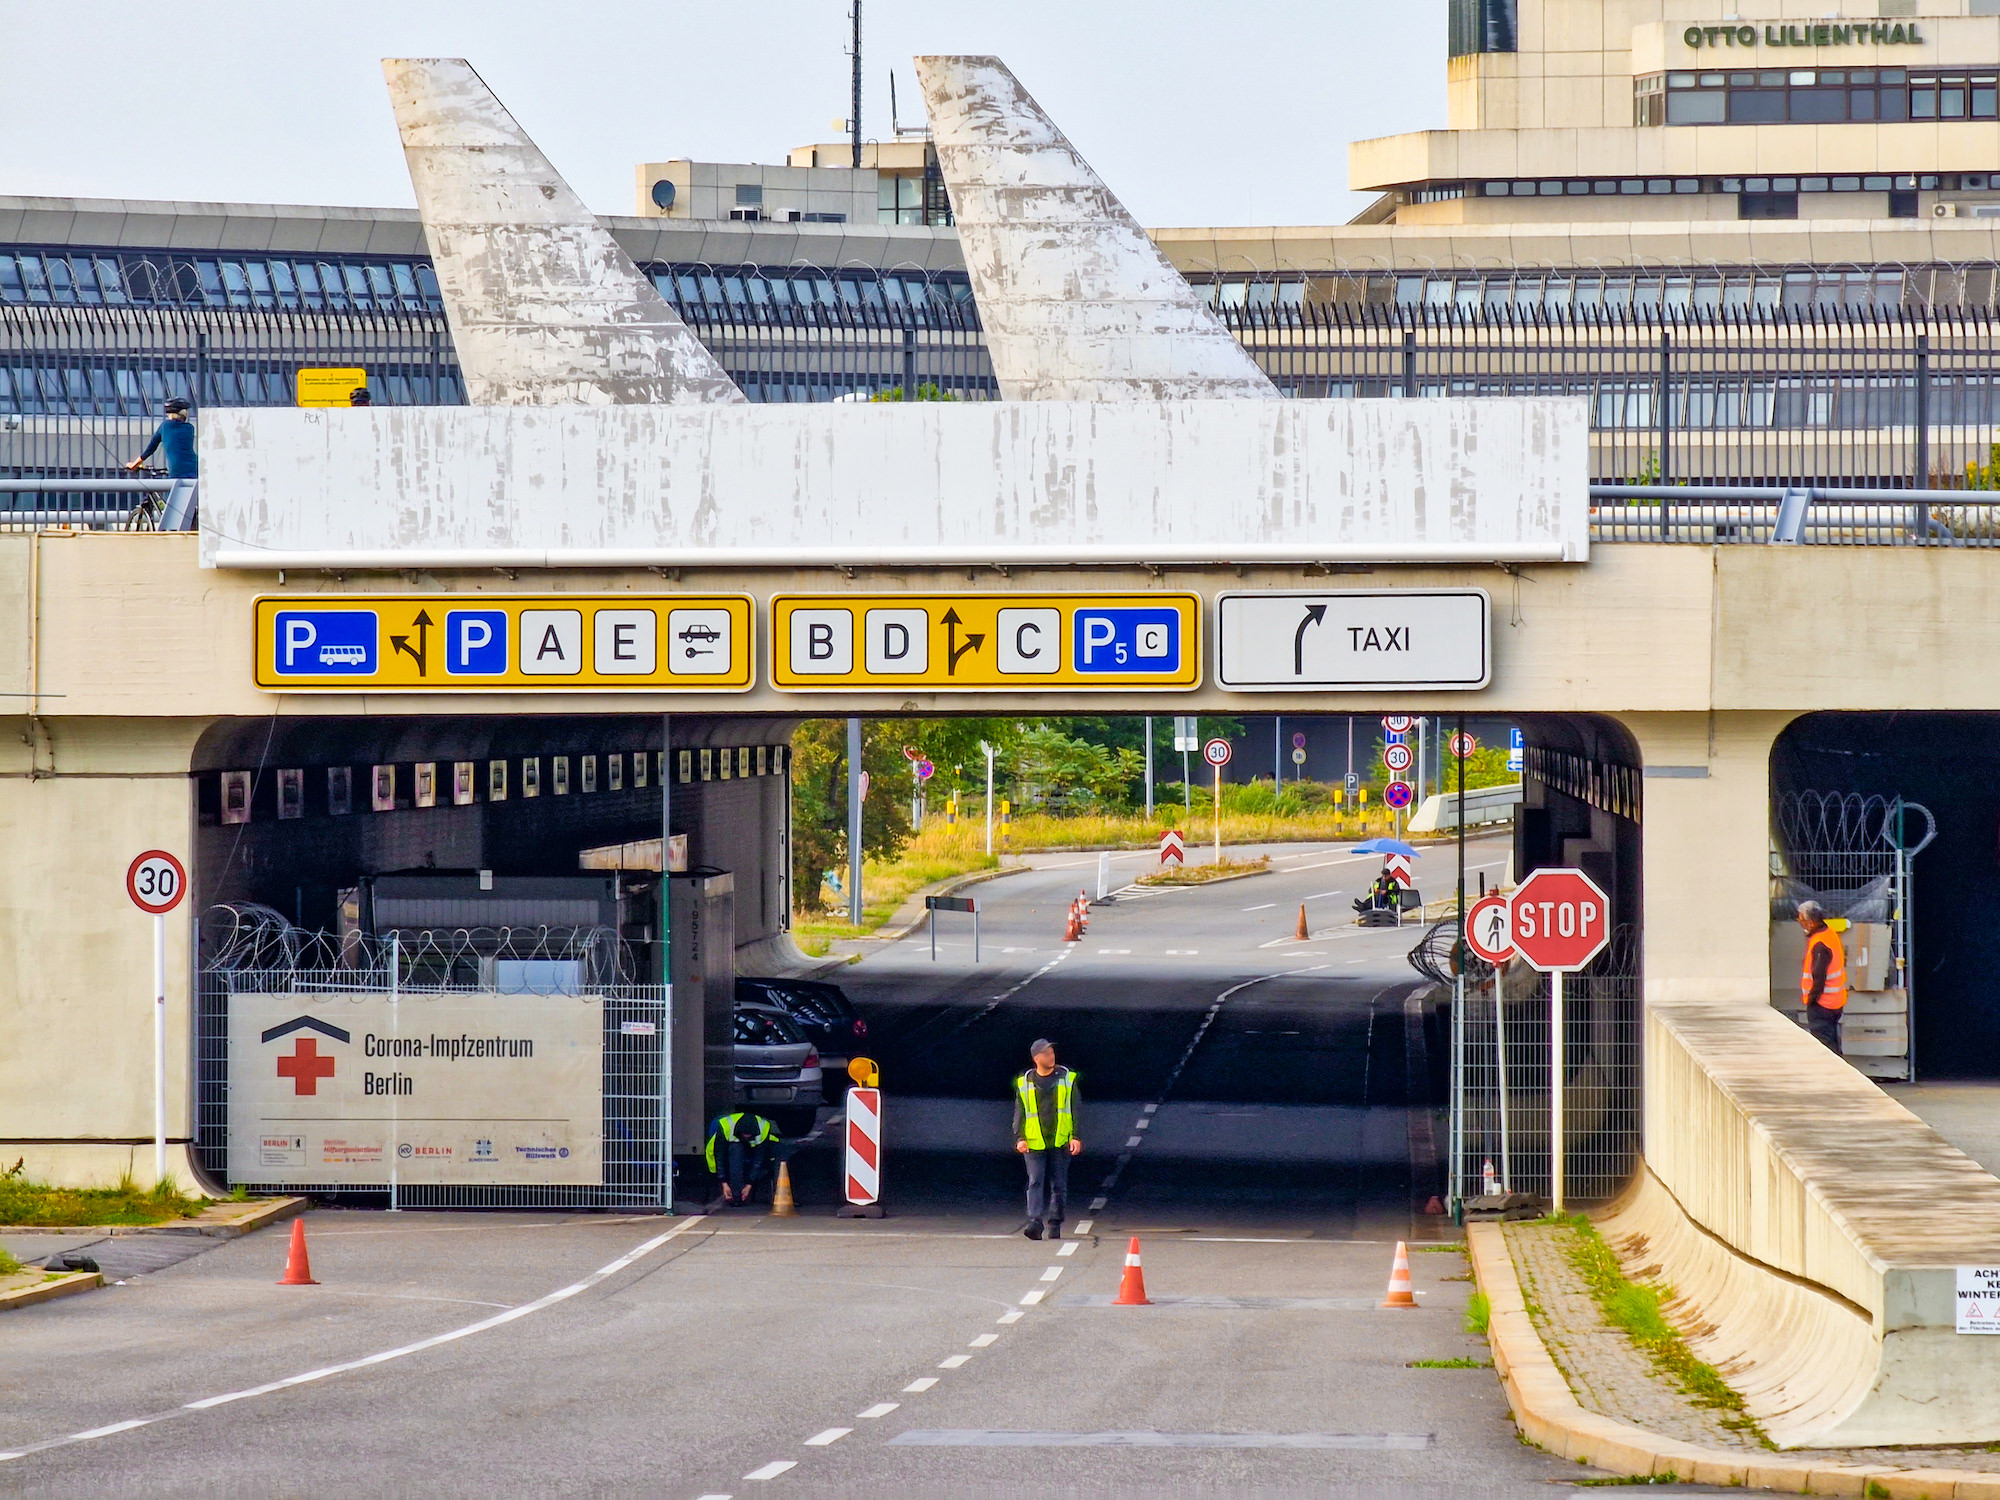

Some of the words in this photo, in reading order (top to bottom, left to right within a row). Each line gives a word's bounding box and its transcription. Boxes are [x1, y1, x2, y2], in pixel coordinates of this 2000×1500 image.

[1684, 25, 1757, 48] OTTO
[1765, 23, 1923, 47] LILIENTHAL
[286, 620, 317, 666] P
[461, 619, 492, 666] P
[536, 624, 565, 660] A
[613, 624, 637, 660] E
[809, 623, 834, 660] B
[884, 623, 909, 660] D
[1016, 622, 1041, 659] C
[1145, 631, 1159, 650] C
[1347, 627, 1410, 652] TAXI
[1210, 746, 1225, 759] 30
[1390, 751, 1406, 764] 30
[1347, 775, 1356, 788] P
[139, 866, 174, 897] 30
[1519, 902, 1598, 938] STOP
[364, 1033, 533, 1062] Corona-Impfzentrum
[364, 1072, 413, 1096] Berlin
[415, 1147, 452, 1155] BERLIN
[1975, 1270, 2000, 1278] ACH
